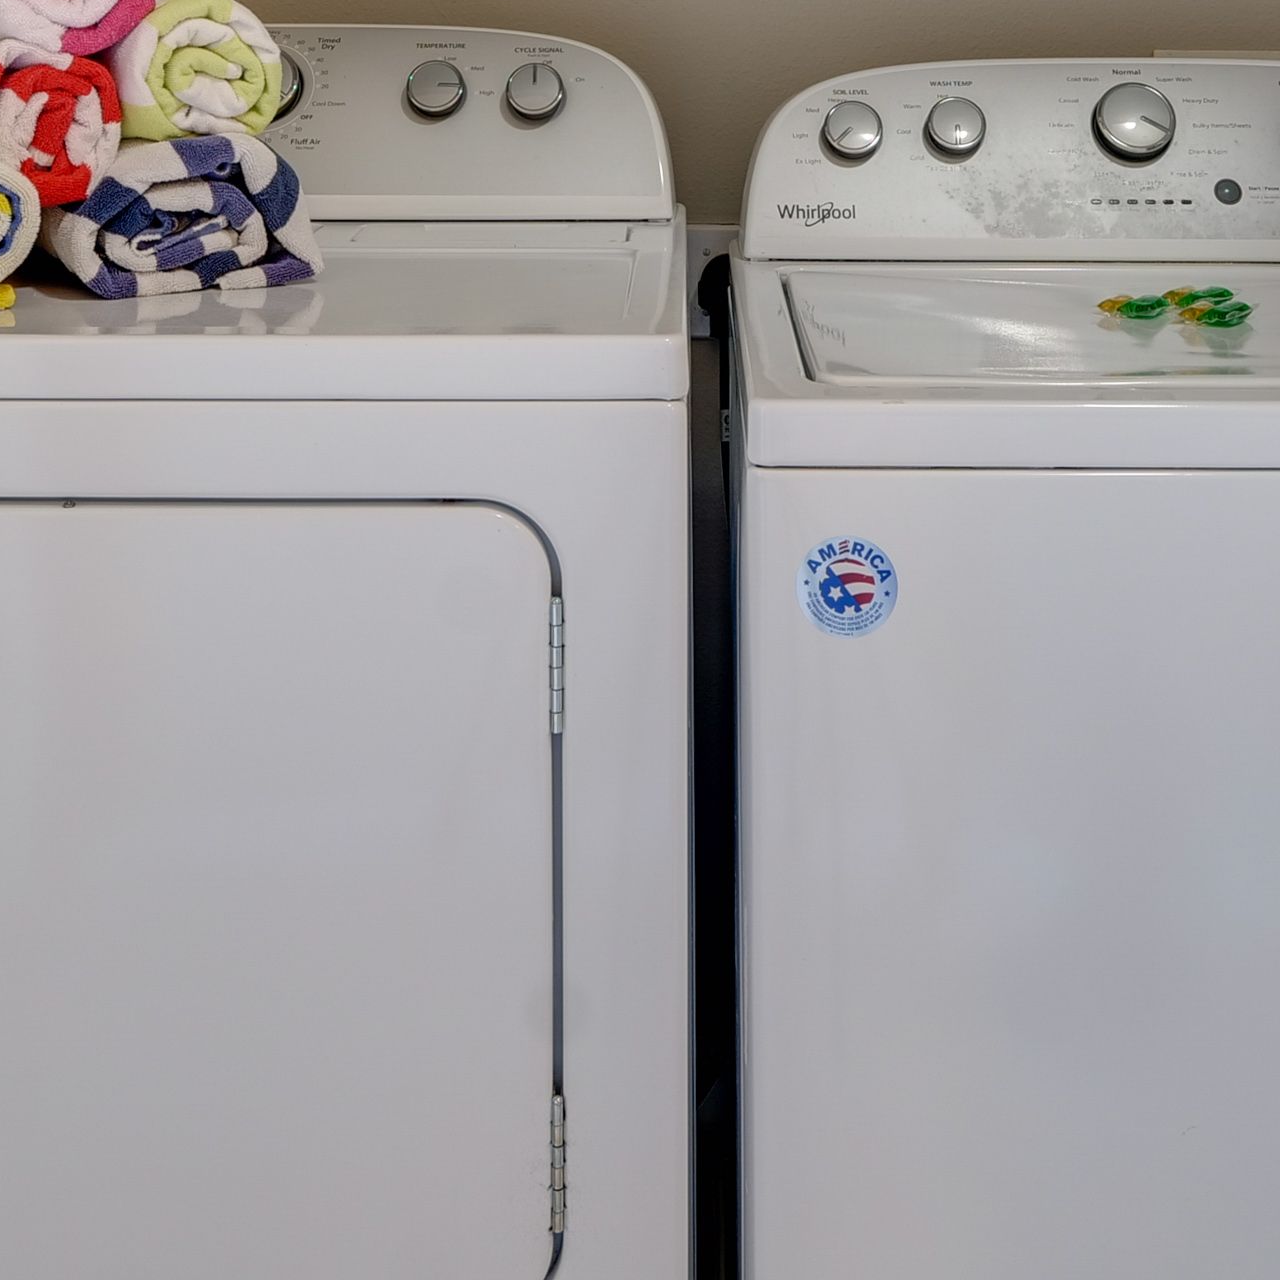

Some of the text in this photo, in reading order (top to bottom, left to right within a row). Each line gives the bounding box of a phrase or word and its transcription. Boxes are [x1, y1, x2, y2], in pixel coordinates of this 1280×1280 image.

[1112, 68, 1141, 76] Normal
[777, 203, 856, 225] Whirlpool
[806, 539, 892, 584] AMERICA
